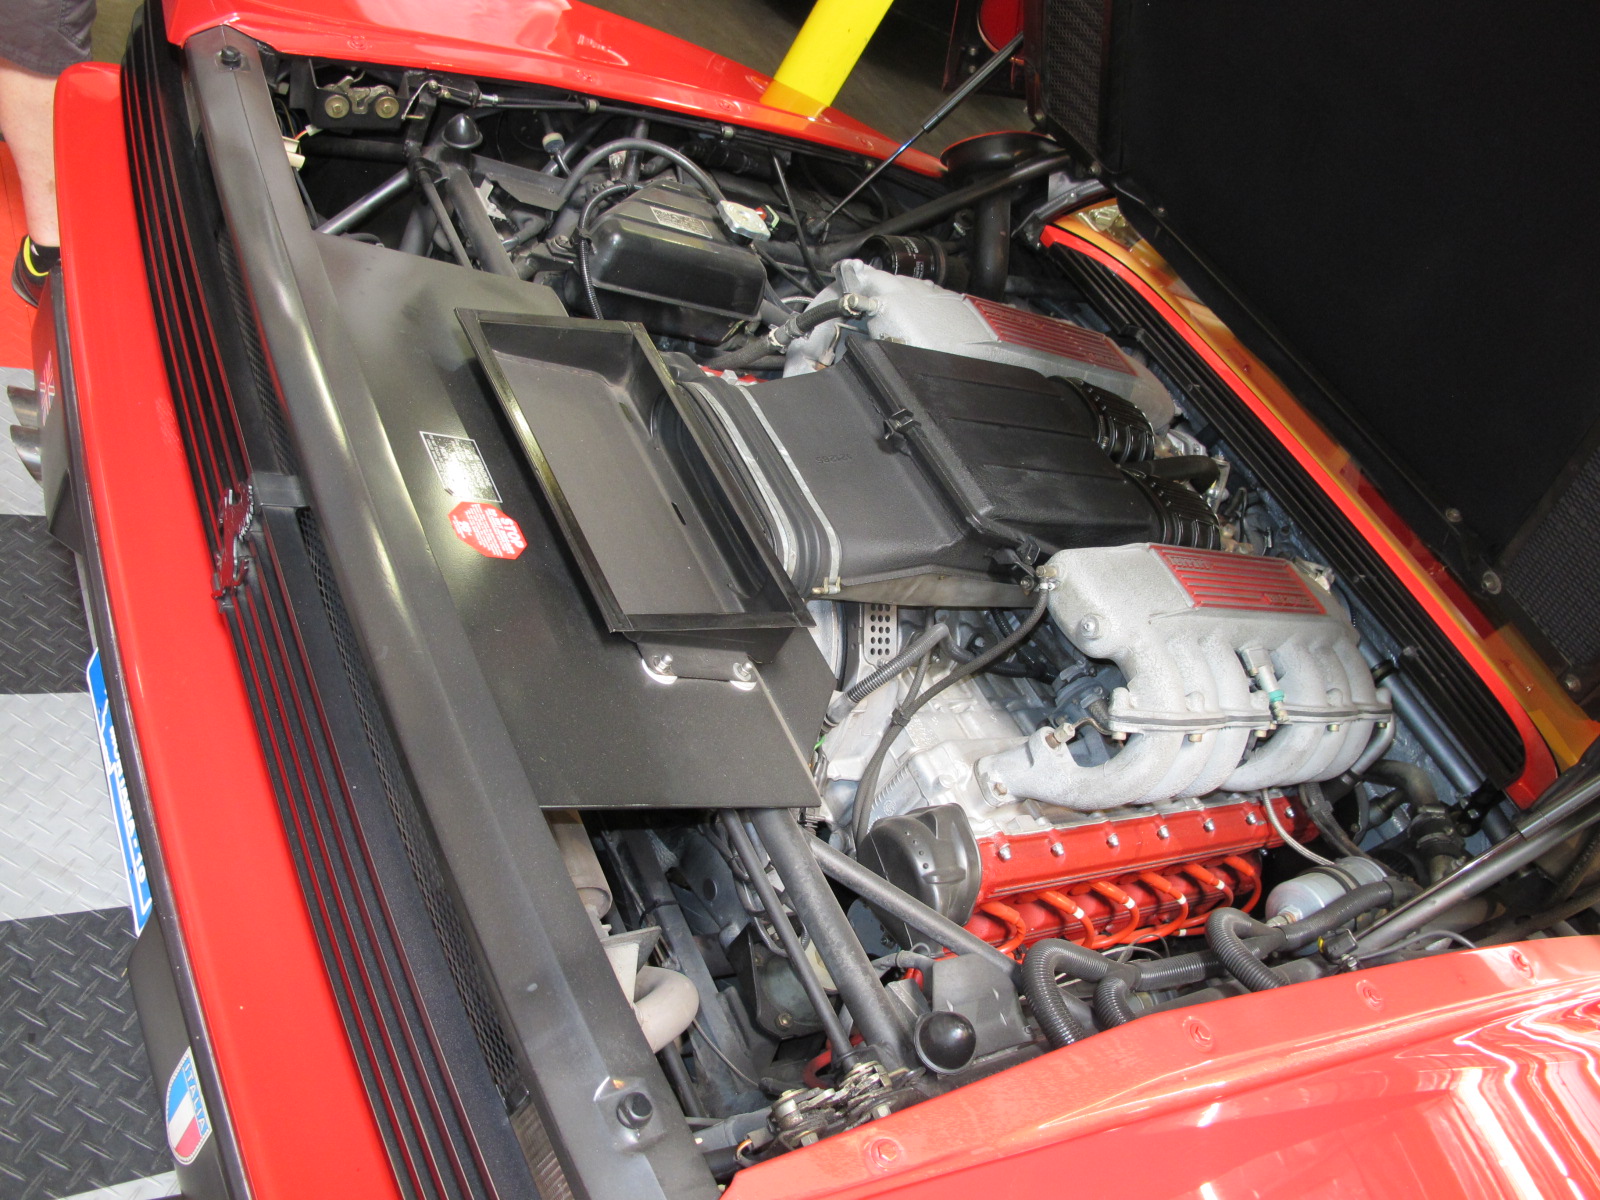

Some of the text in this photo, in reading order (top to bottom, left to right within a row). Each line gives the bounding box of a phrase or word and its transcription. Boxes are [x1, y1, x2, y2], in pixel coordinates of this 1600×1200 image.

[500, 518, 524, 548] STOP
[135, 853, 146, 883] 10
[184, 1063, 206, 1131] ITALIA
